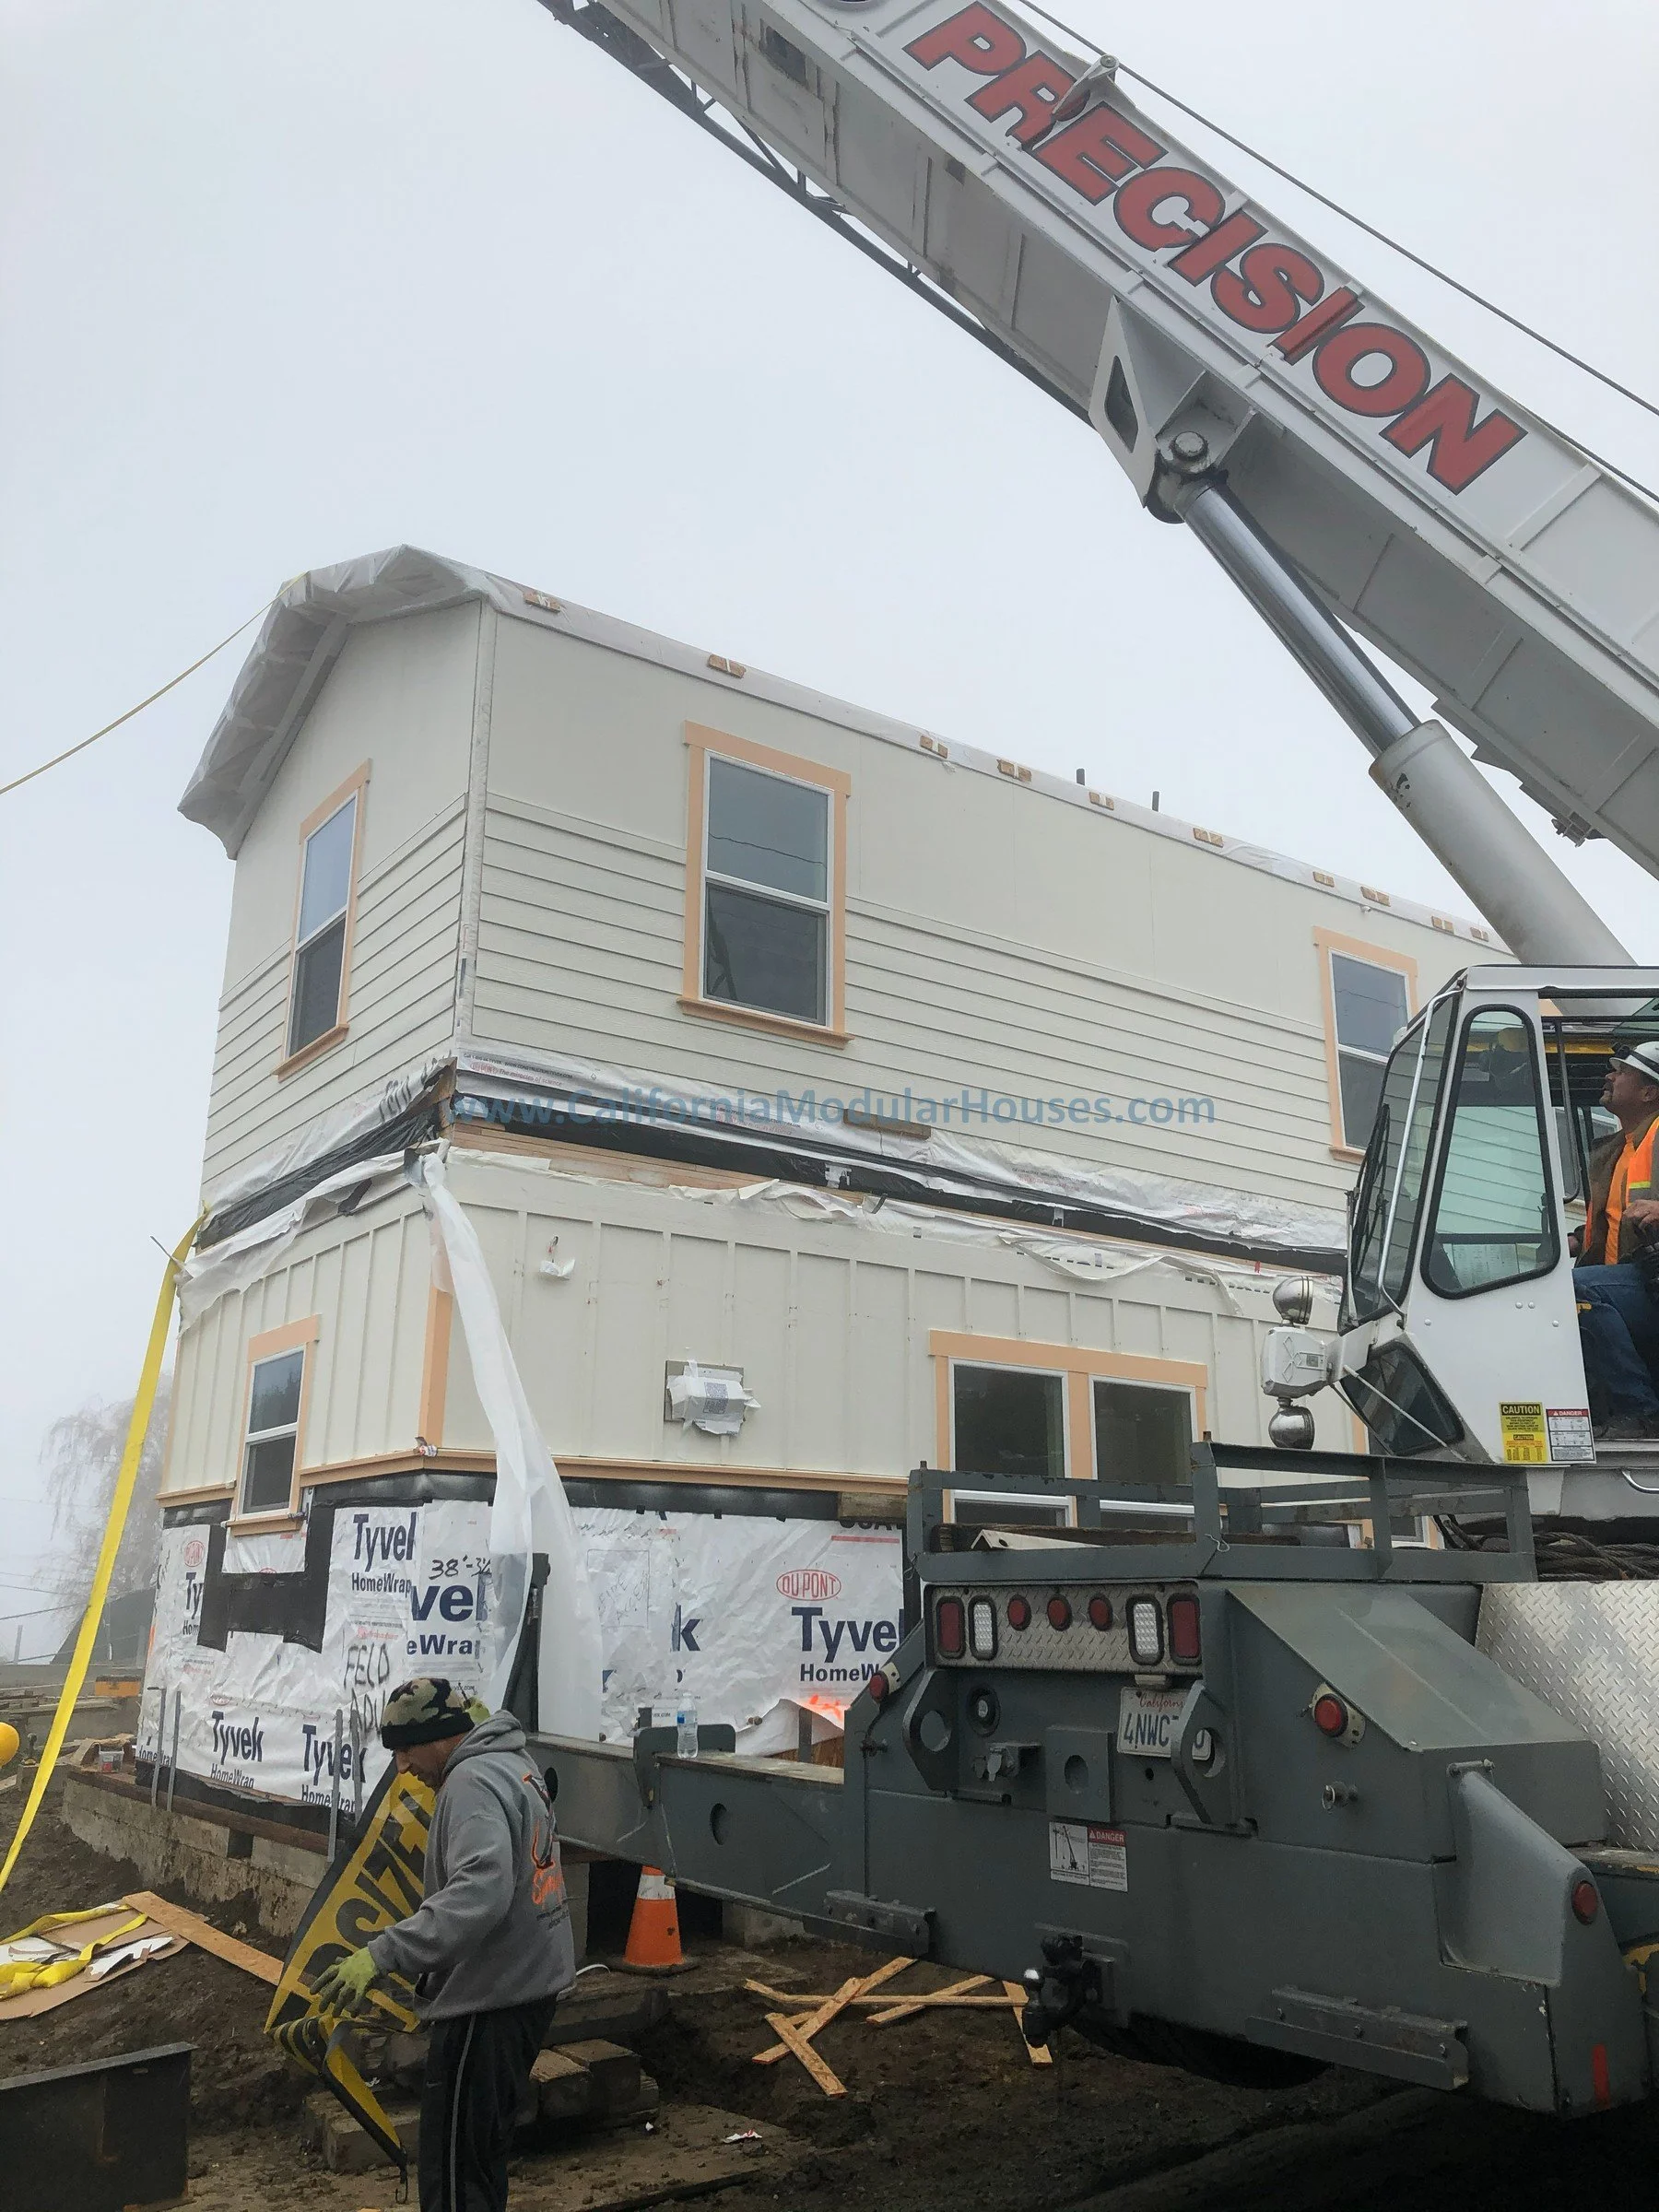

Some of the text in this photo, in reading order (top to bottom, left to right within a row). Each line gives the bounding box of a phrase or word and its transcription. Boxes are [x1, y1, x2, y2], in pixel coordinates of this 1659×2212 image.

[903, 1, 1527, 495] PRECISION
[1502, 1406, 1539, 1415] CAUTION
[1139, 1693, 1185, 1712] Californi
[211, 1710, 264, 1766] Tyvek
[1097, 1831, 1124, 1842] DANGER
